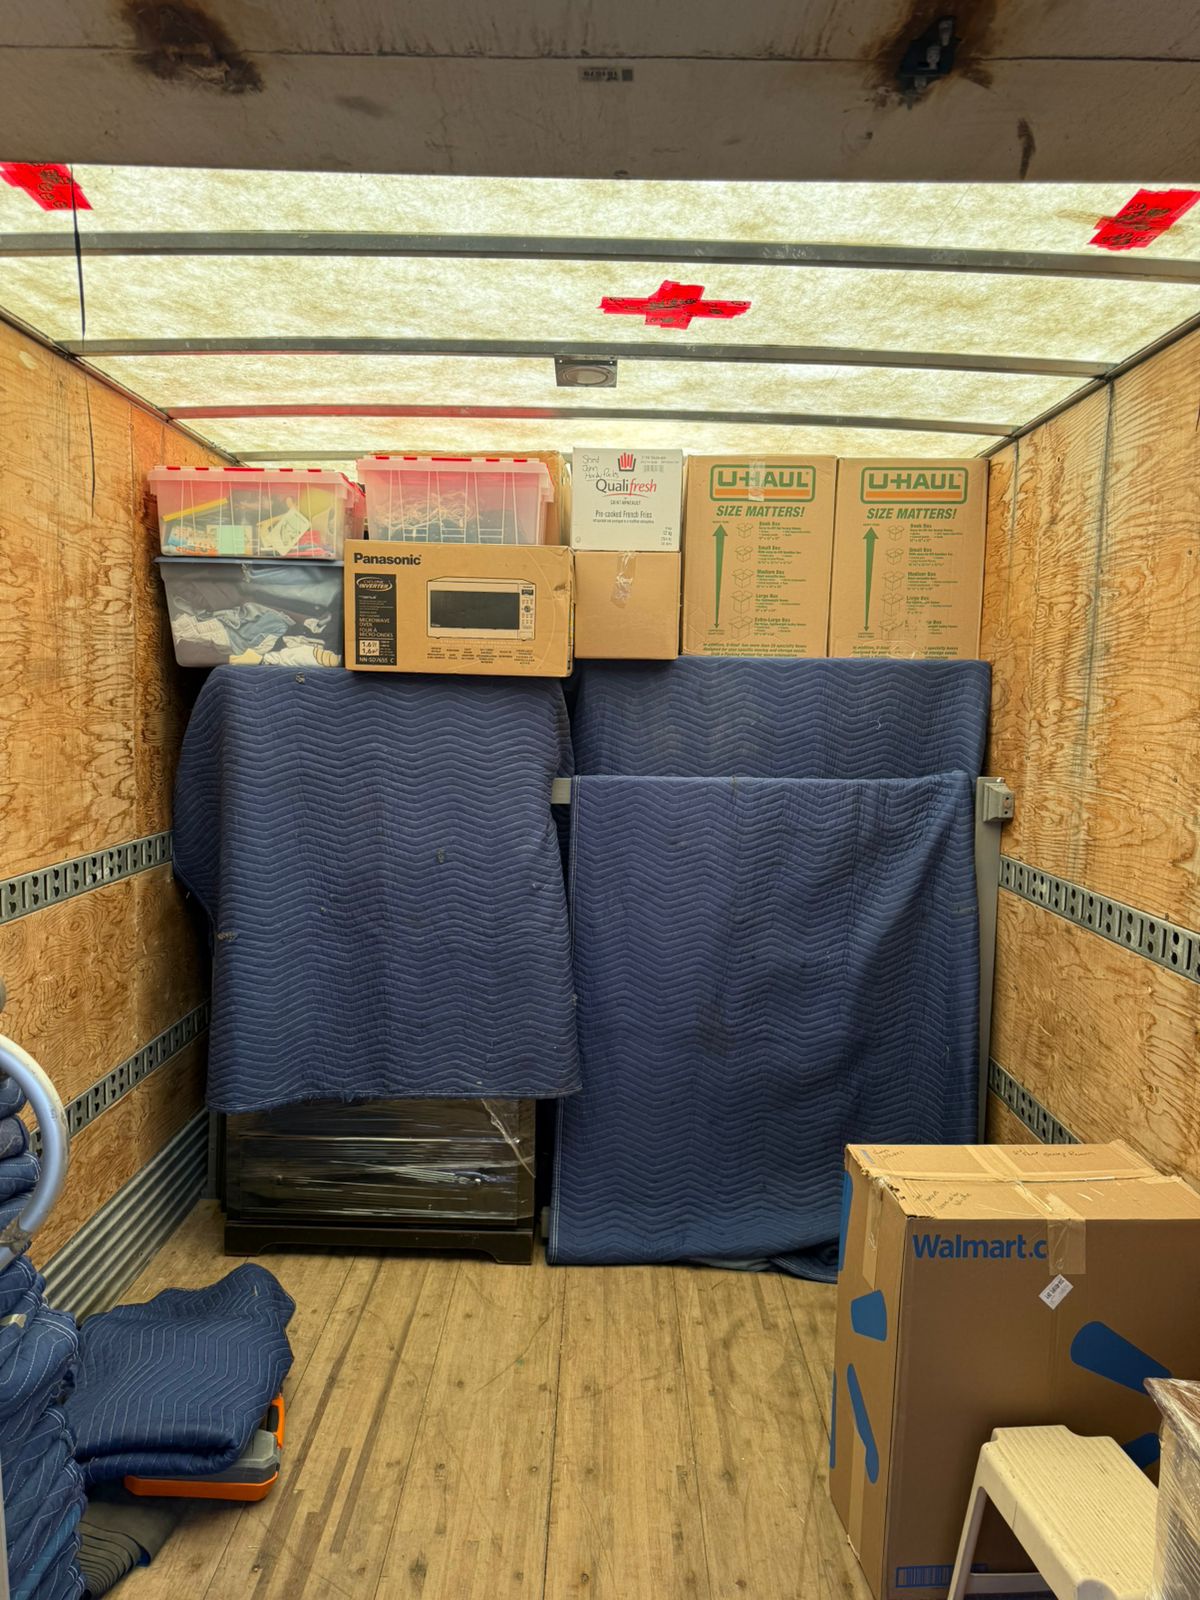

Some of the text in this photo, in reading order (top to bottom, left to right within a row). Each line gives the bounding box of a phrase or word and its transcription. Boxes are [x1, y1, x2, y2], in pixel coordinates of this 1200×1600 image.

[717, 470, 809, 488] U-HAUL
[868, 473, 962, 490] U-HAUL
[595, 478, 657, 496] Qualifresh
[716, 505, 805, 518] SIZE MATTERS!
[867, 508, 958, 520] SIZE MATTERS!
[354, 552, 421, 566] Panasonic
